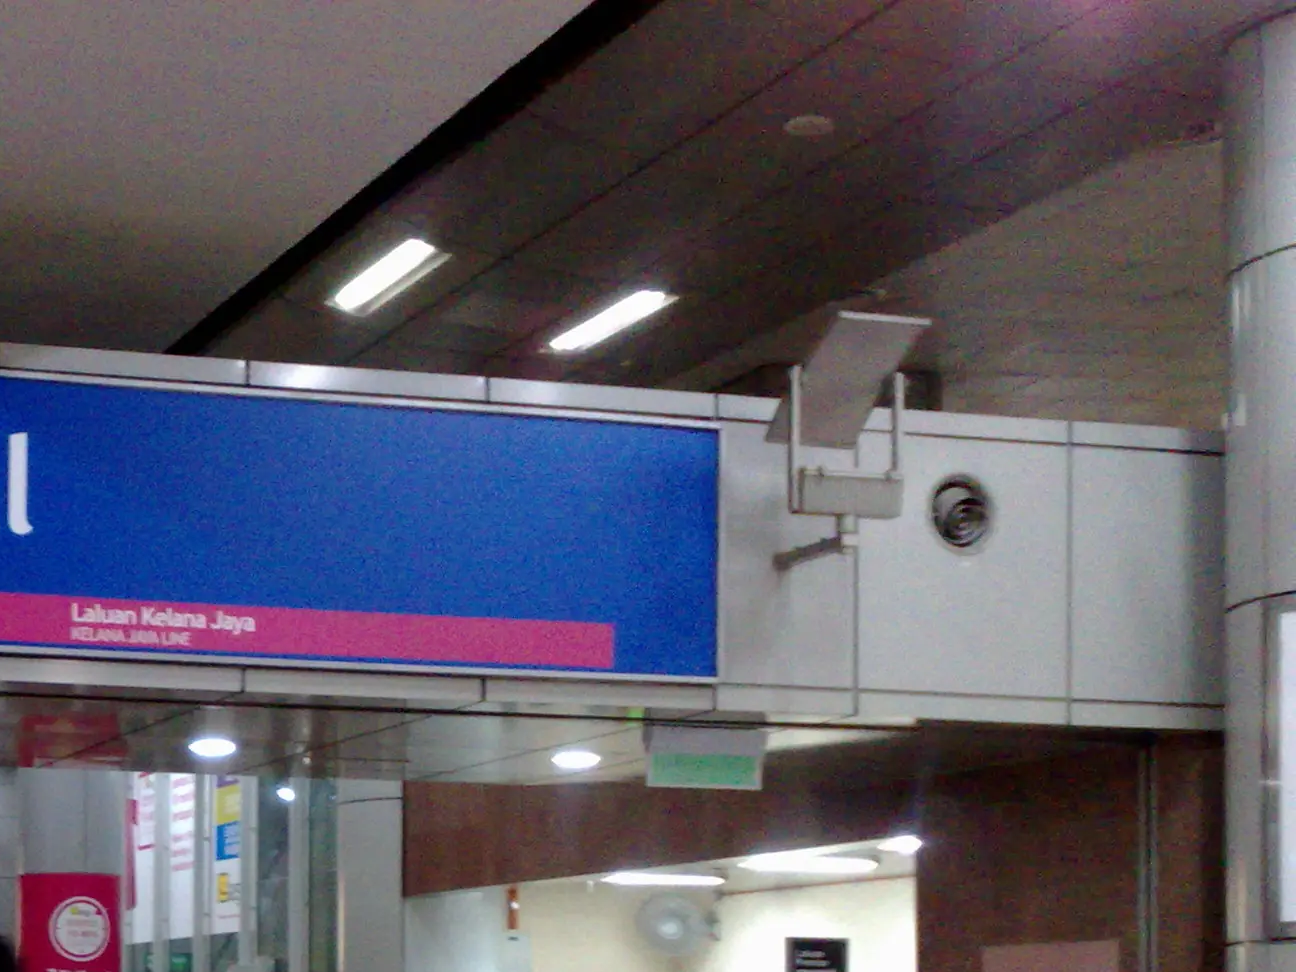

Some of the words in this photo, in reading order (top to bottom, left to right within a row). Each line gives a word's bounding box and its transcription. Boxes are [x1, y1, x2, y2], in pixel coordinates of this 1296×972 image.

[70, 603, 137, 625] Laluan
[140, 606, 206, 628] Kelana
[209, 610, 257, 635] Jaya
